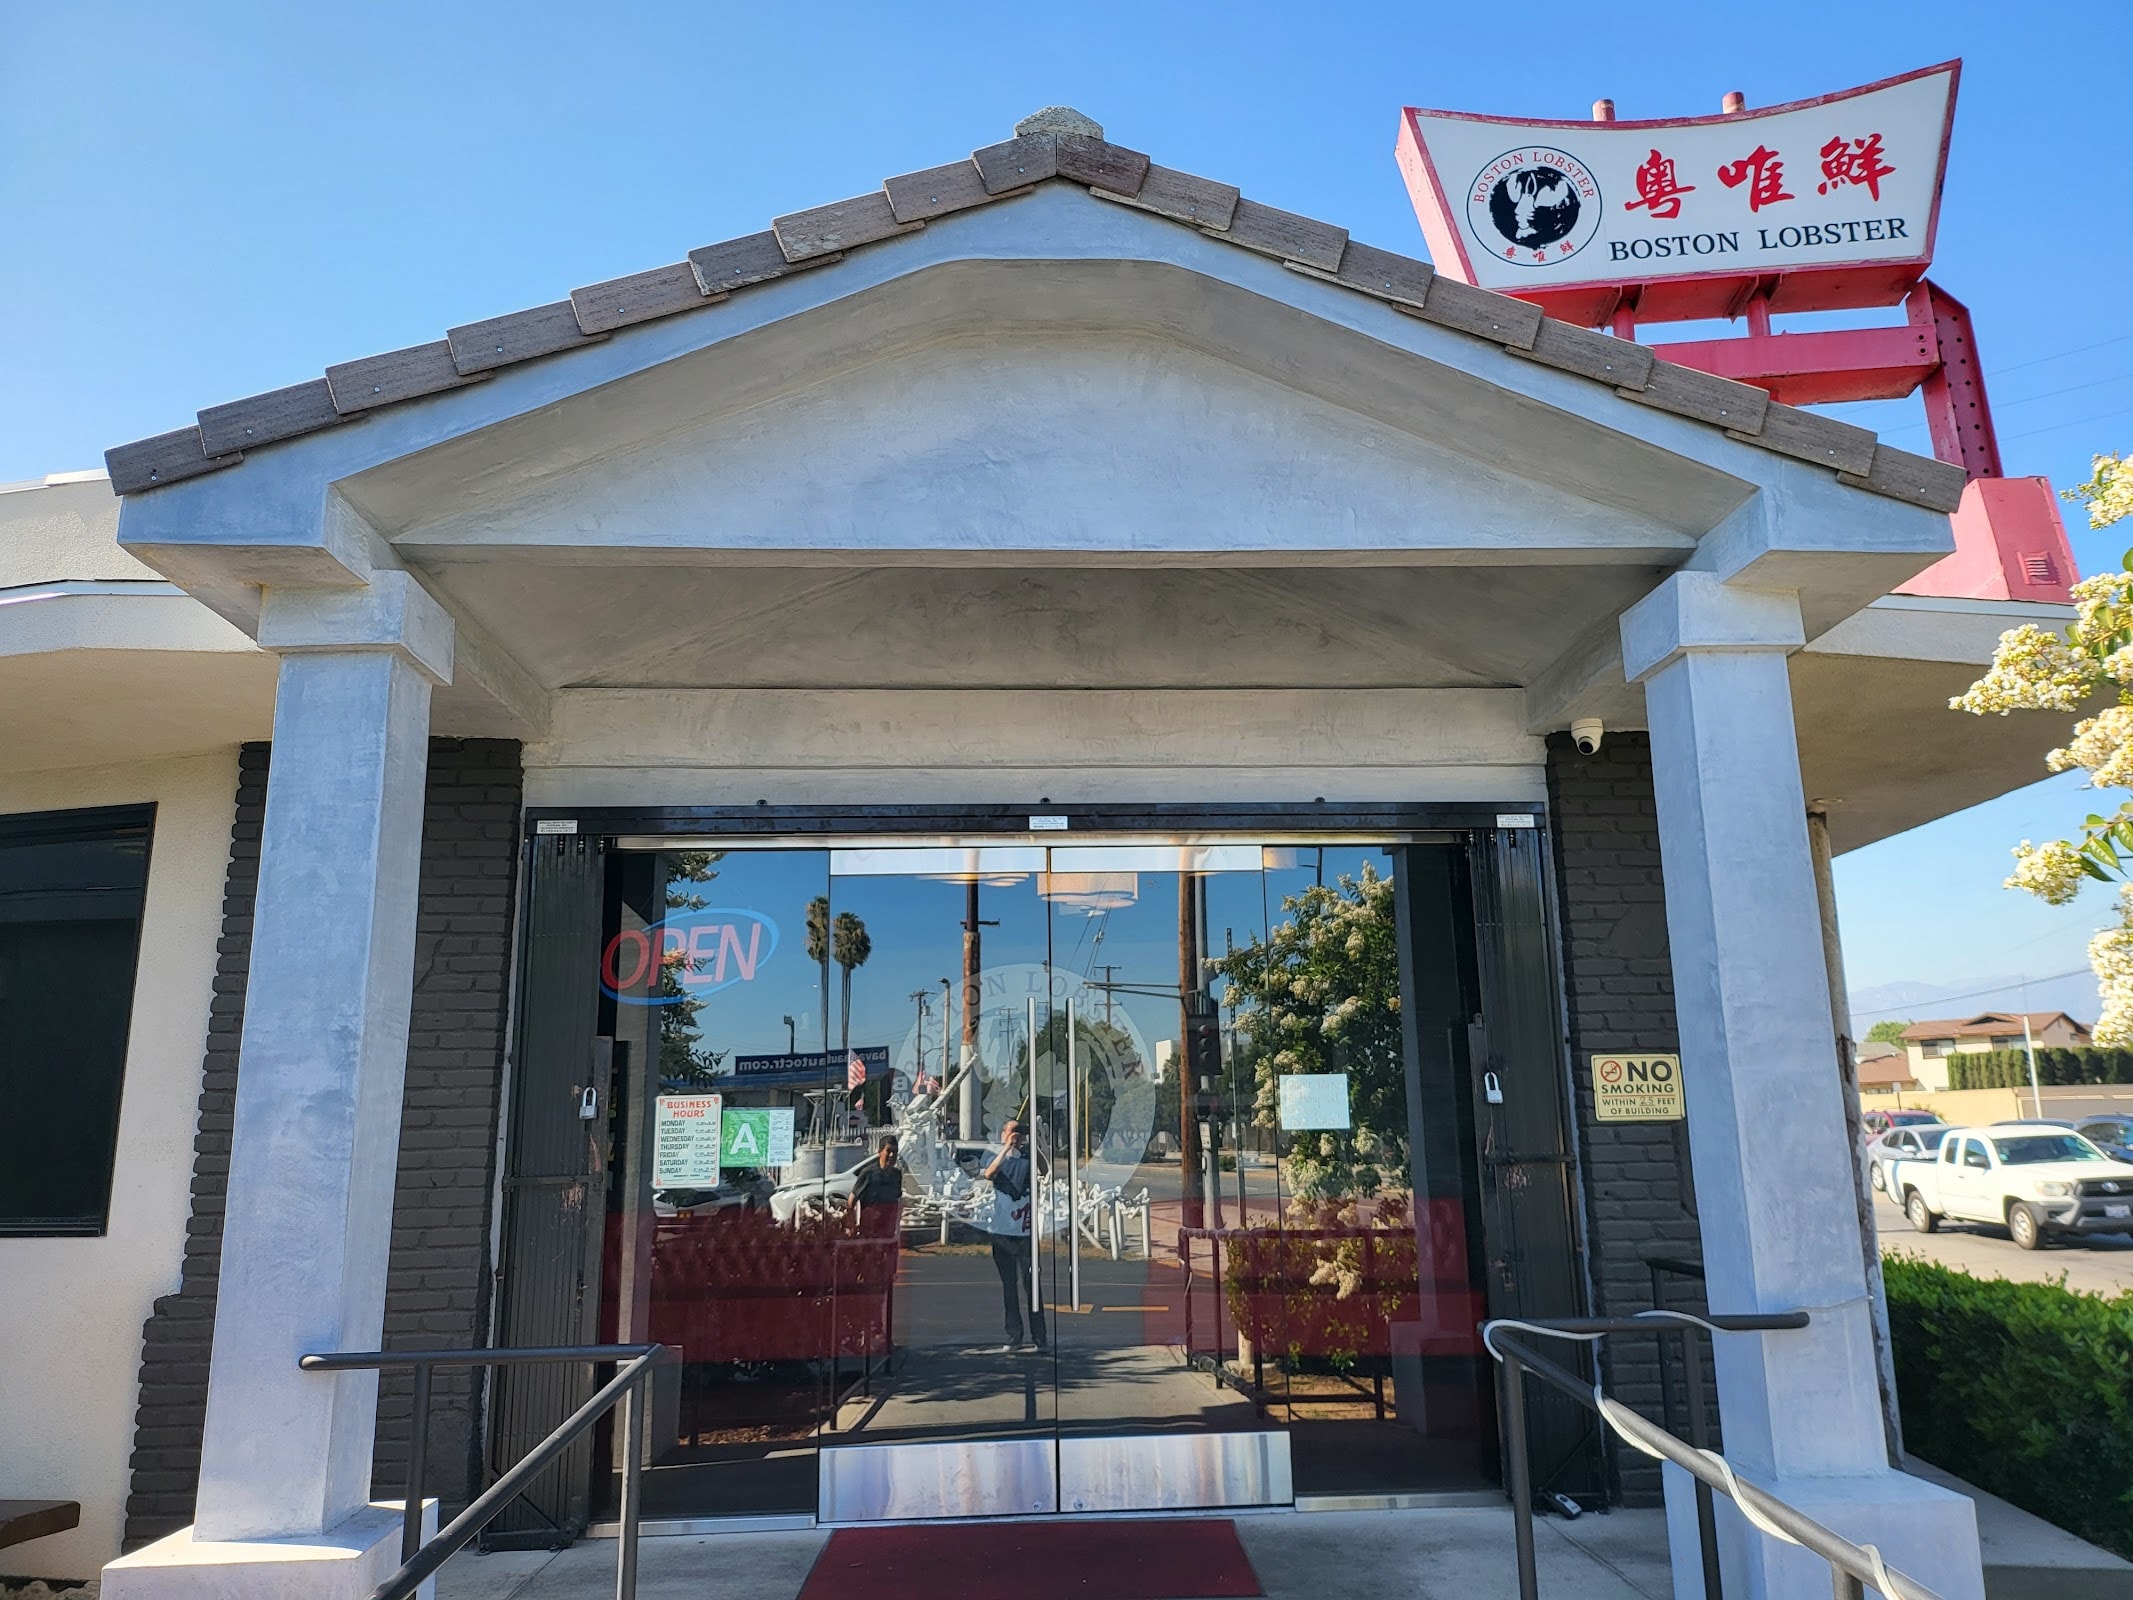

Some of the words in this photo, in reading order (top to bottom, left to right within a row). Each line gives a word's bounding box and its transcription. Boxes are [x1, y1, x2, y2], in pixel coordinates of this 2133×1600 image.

[1473, 153, 1525, 203] BOSTON
[1532, 151, 1595, 198] LOBSTER
[1609, 231, 1740, 261] BOSTON
[1757, 217, 1909, 250] LOBSTER
[602, 923, 762, 990] OPEN
[1626, 1060, 1673, 1082] NO
[1601, 1083, 1674, 1094] SMOKING
[667, 1100, 712, 1109] BUSINESS
[1602, 1098, 1636, 1106] WITHIN
[1640, 1096, 1654, 1105] 25
[1657, 1097, 1676, 1105] FEET
[673, 1109, 705, 1118] HOURS
[1610, 1107, 1622, 1115] OF
[1625, 1107, 1669, 1115] BUILDING
[660, 1135, 694, 1143] WEDNESDAY
[729, 1122, 760, 1155] A
